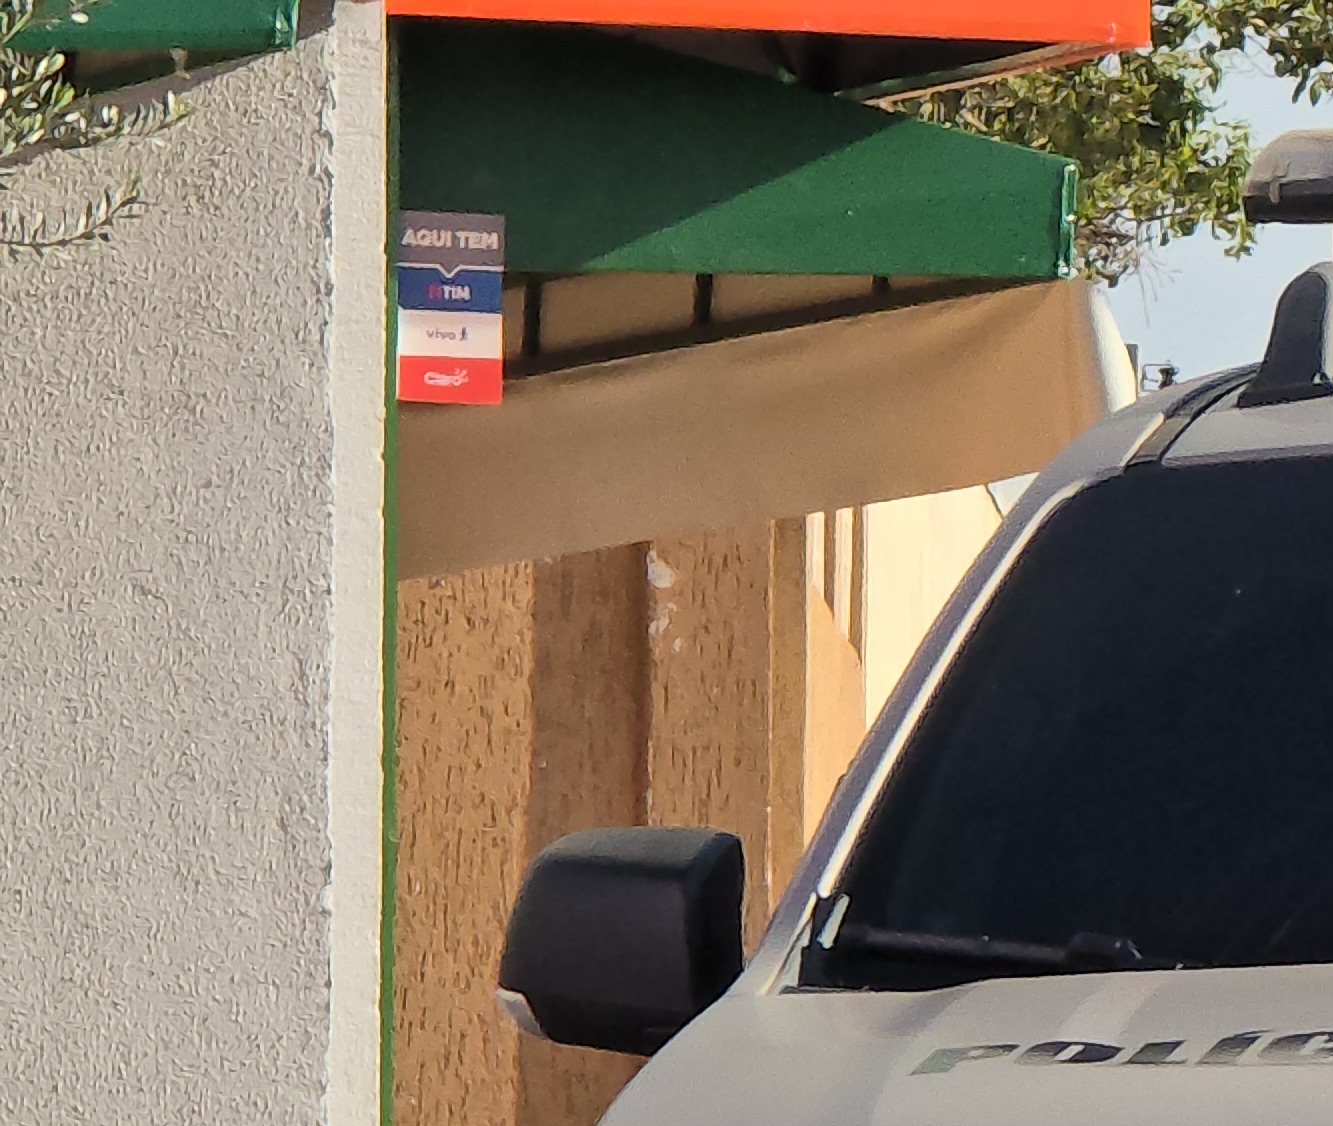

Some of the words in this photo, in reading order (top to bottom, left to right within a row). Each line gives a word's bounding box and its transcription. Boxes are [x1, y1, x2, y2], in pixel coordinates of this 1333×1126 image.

[402, 227, 453, 249] AQUI
[456, 229, 499, 250] TEM
[443, 285, 471, 301] TIM
